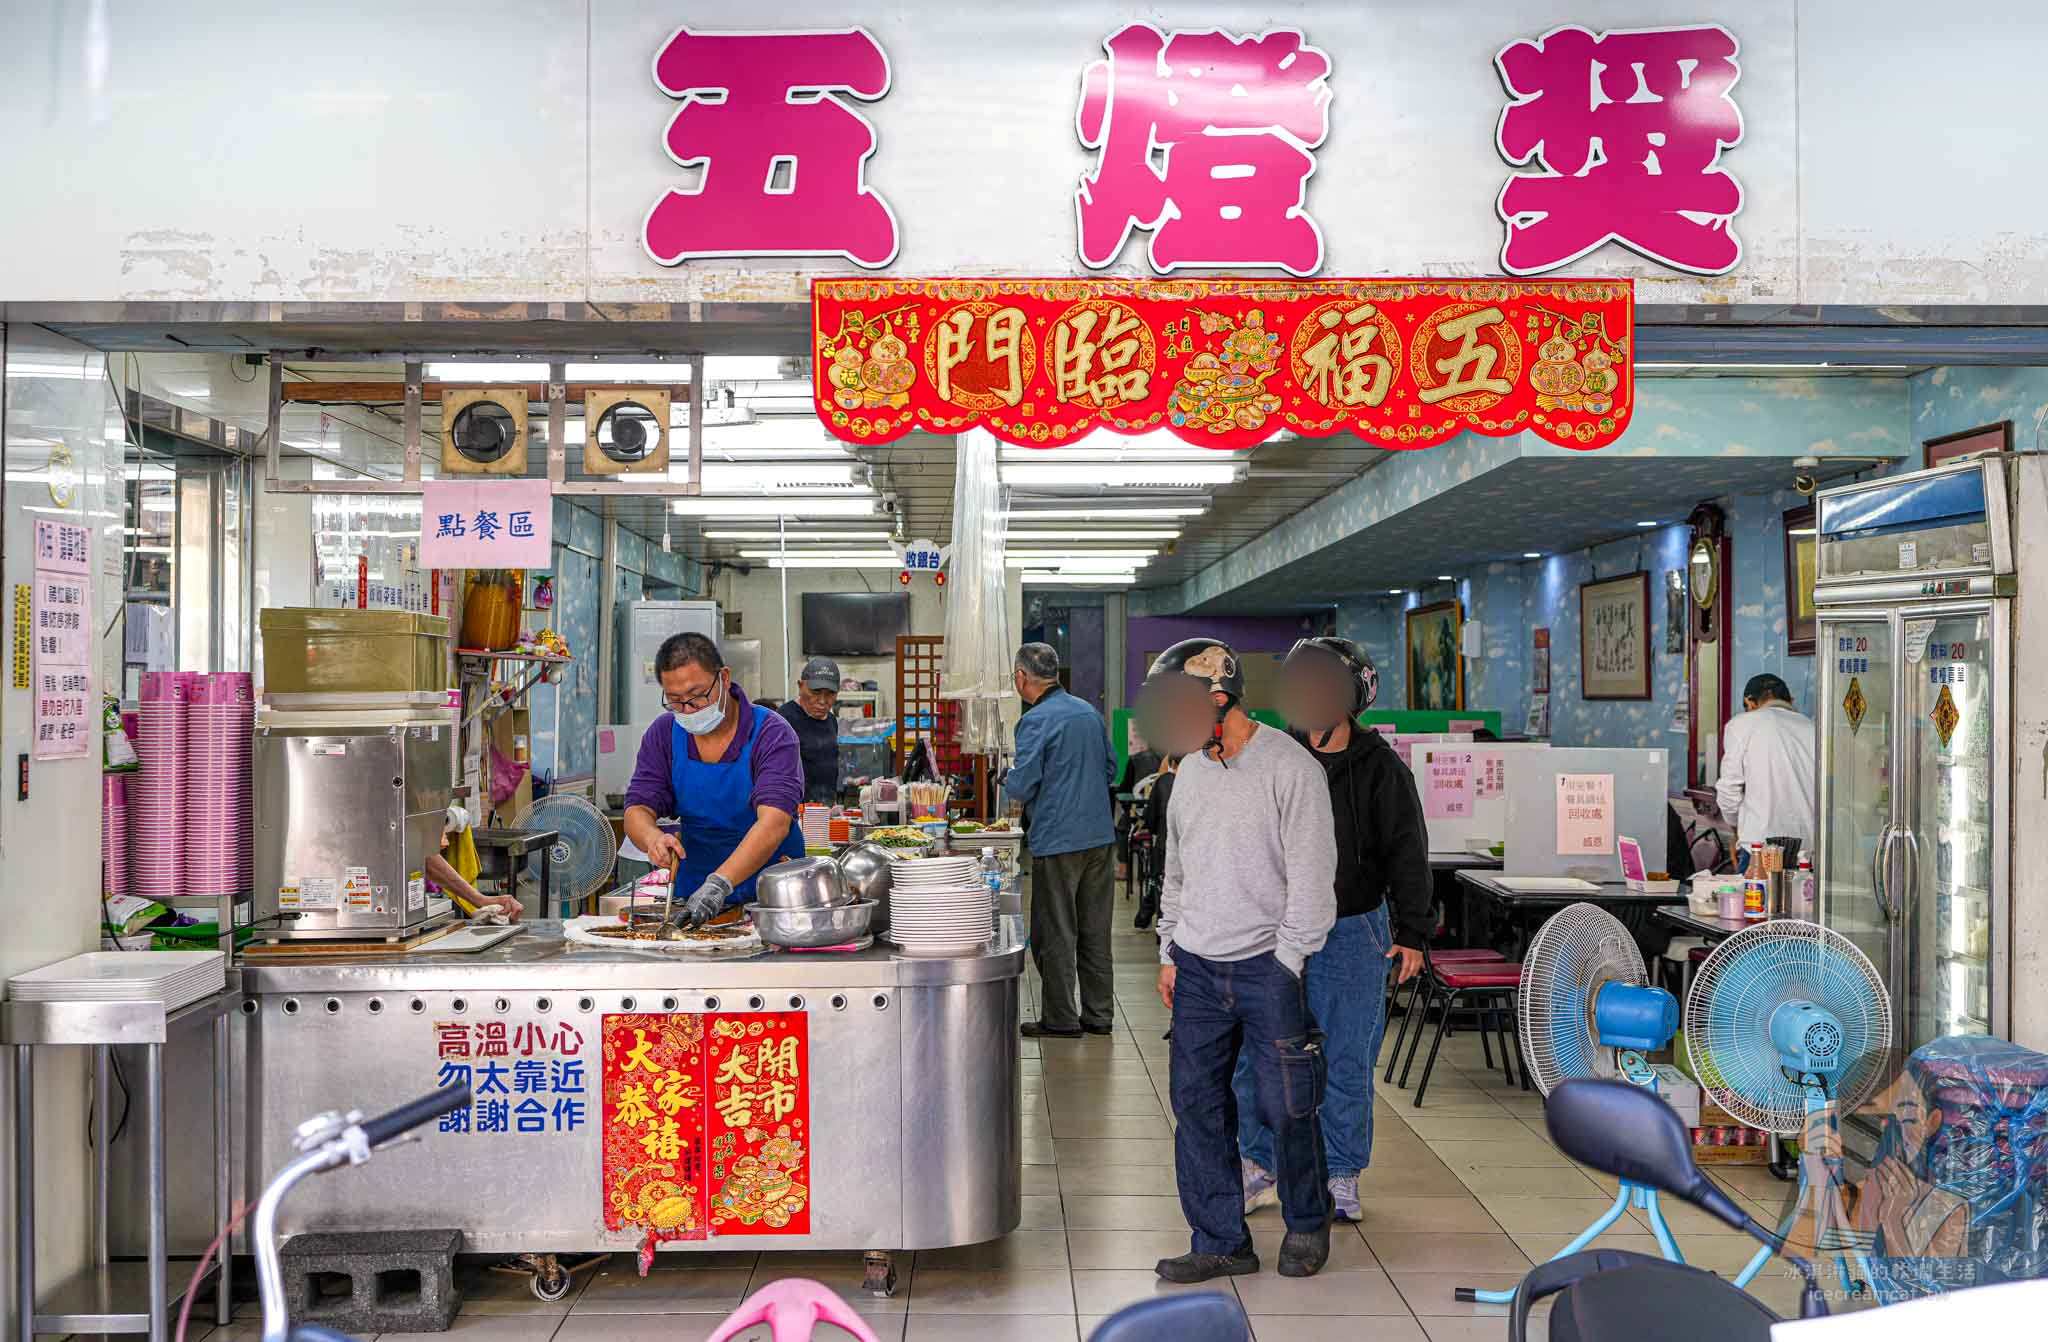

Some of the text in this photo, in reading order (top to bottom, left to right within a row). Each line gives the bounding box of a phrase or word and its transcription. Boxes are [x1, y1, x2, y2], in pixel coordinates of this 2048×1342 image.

[641, 23, 1745, 275] 五燈獎
[436, 510, 535, 540] 點餐區
[906, 551, 940, 569] 收銀台
[1856, 637, 1867, 652] 20
[1951, 644, 1965, 659] 20
[1465, 755, 1472, 763] 2
[1561, 778, 1566, 786] 1
[1568, 808, 1603, 819] 回收處
[438, 1022, 584, 1057] 高溫小心
[438, 1060, 585, 1095] 勿太靠近
[714, 1045, 758, 1128] 大吉
[756, 1036, 799, 1123] 開市
[439, 1098, 585, 1133] 謝謝合作
